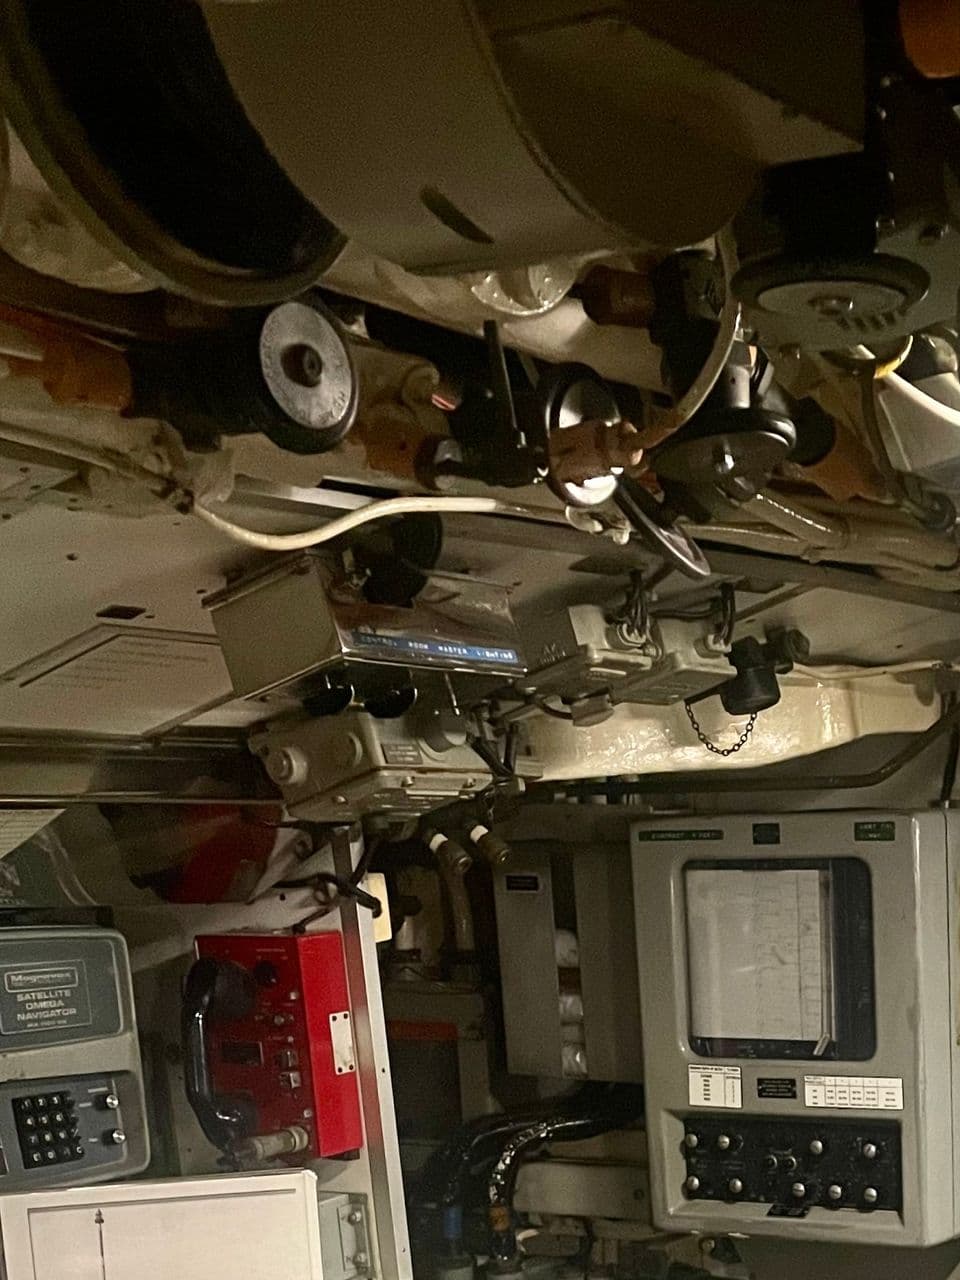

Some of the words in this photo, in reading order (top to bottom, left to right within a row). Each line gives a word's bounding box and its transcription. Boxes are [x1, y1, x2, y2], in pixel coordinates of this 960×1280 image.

[438, 645, 468, 656] MASTER
[17, 989, 71, 1001] SATELLITE
[25, 1000, 65, 1010] OMEGA
[17, 1008, 77, 1021] NAVIGATOR
